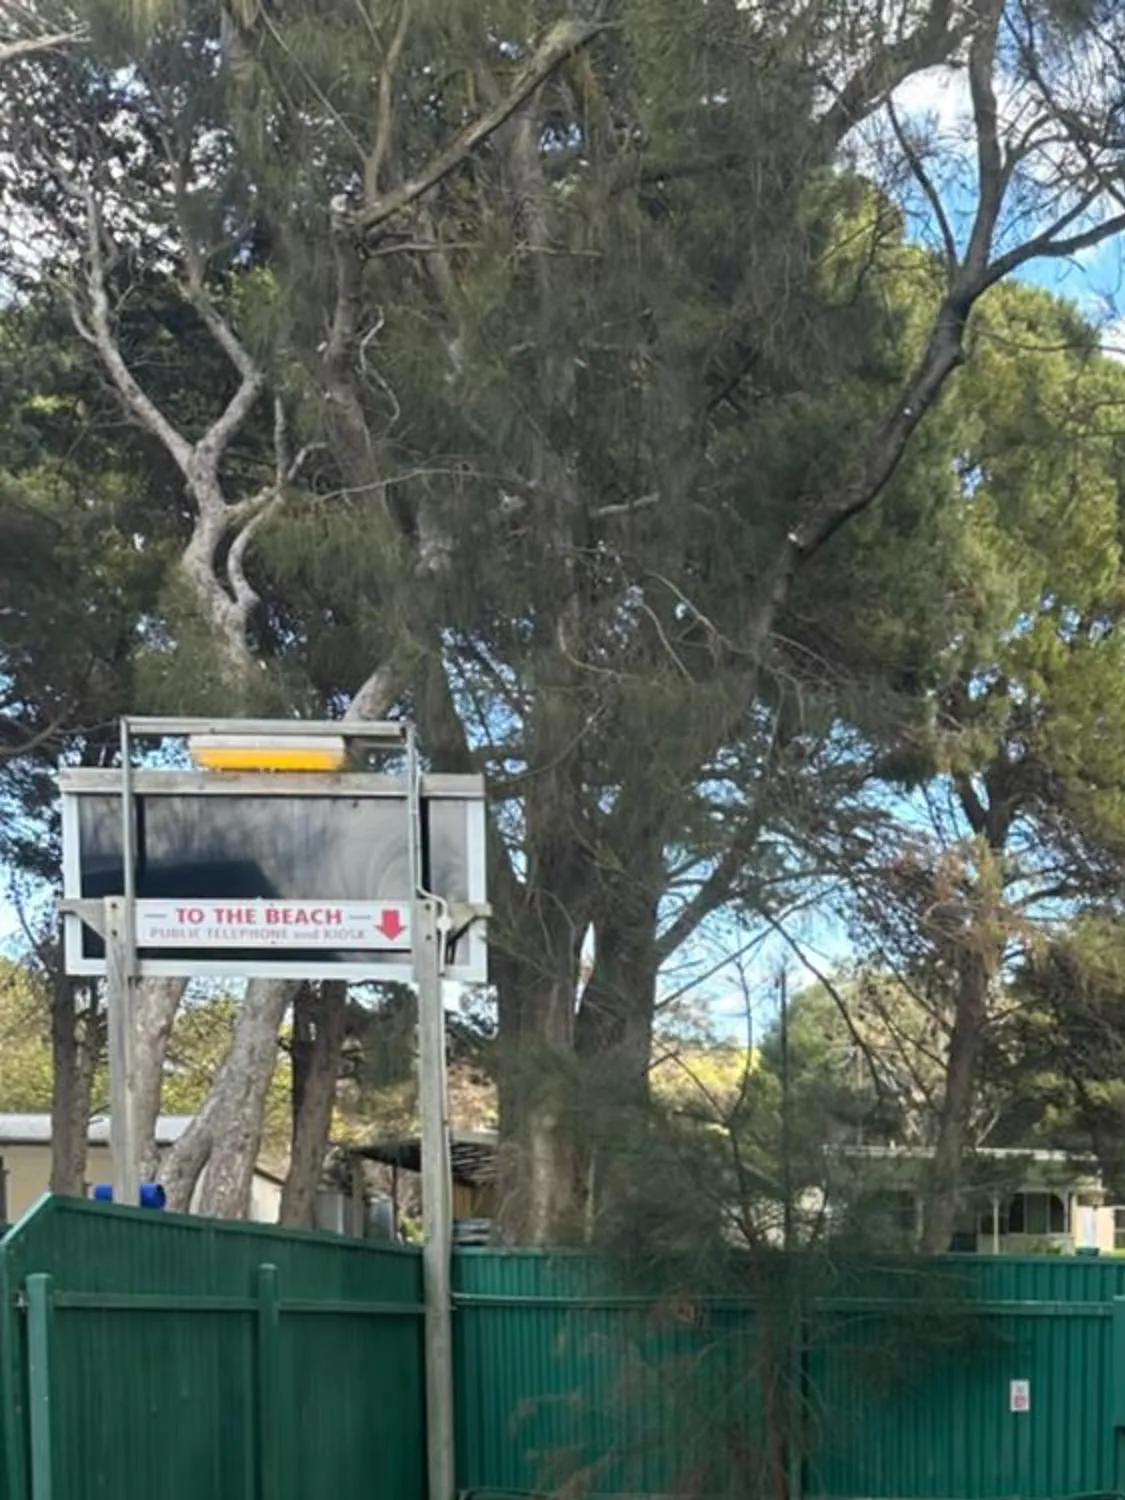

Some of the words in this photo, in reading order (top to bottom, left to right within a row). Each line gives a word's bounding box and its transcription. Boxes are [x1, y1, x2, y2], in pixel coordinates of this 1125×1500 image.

[176, 907, 204, 925] TO
[214, 907, 257, 925] THE
[265, 907, 342, 925] BEACH
[149, 927, 200, 938] PUBLIC
[207, 928, 287, 939] TELEPHONE
[324, 929, 365, 940] KIOSK
